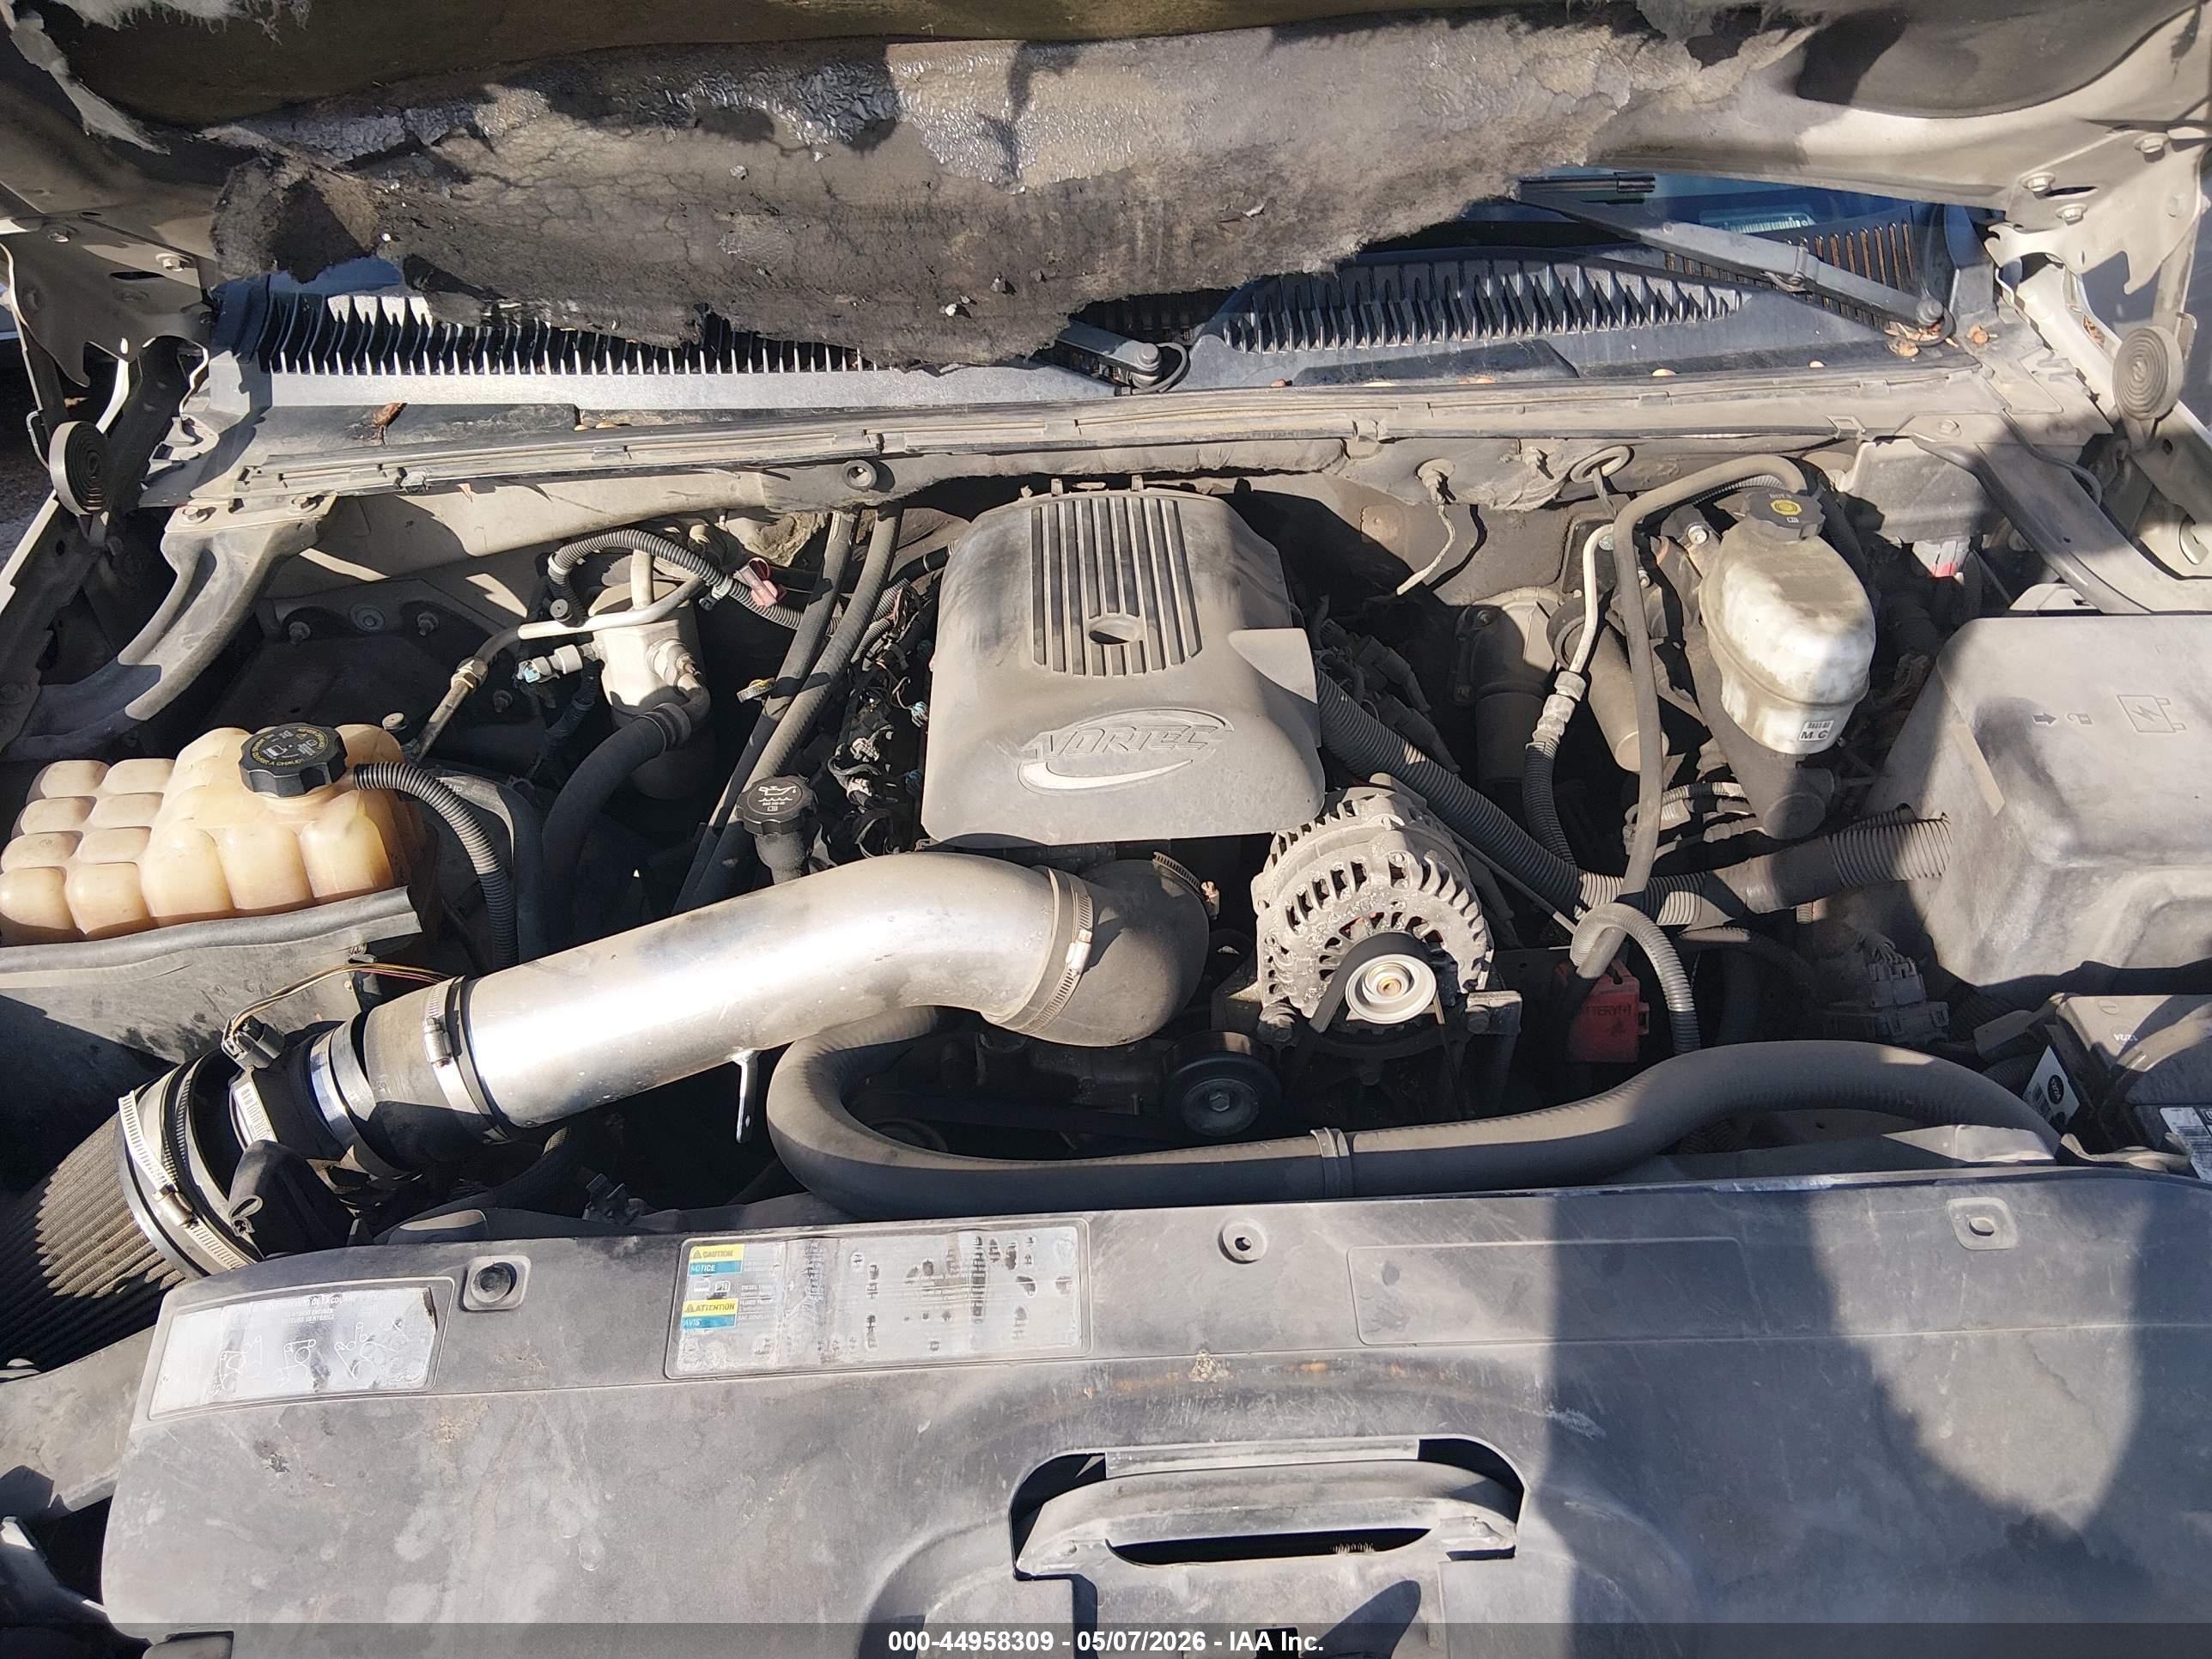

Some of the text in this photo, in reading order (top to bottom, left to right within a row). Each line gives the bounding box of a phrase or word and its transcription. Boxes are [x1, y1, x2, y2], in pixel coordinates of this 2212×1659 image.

[1801, 731, 1814, 739] M
[1025, 724, 1219, 760] VORTEC
[696, 1304, 736, 1312] ATTENTION
